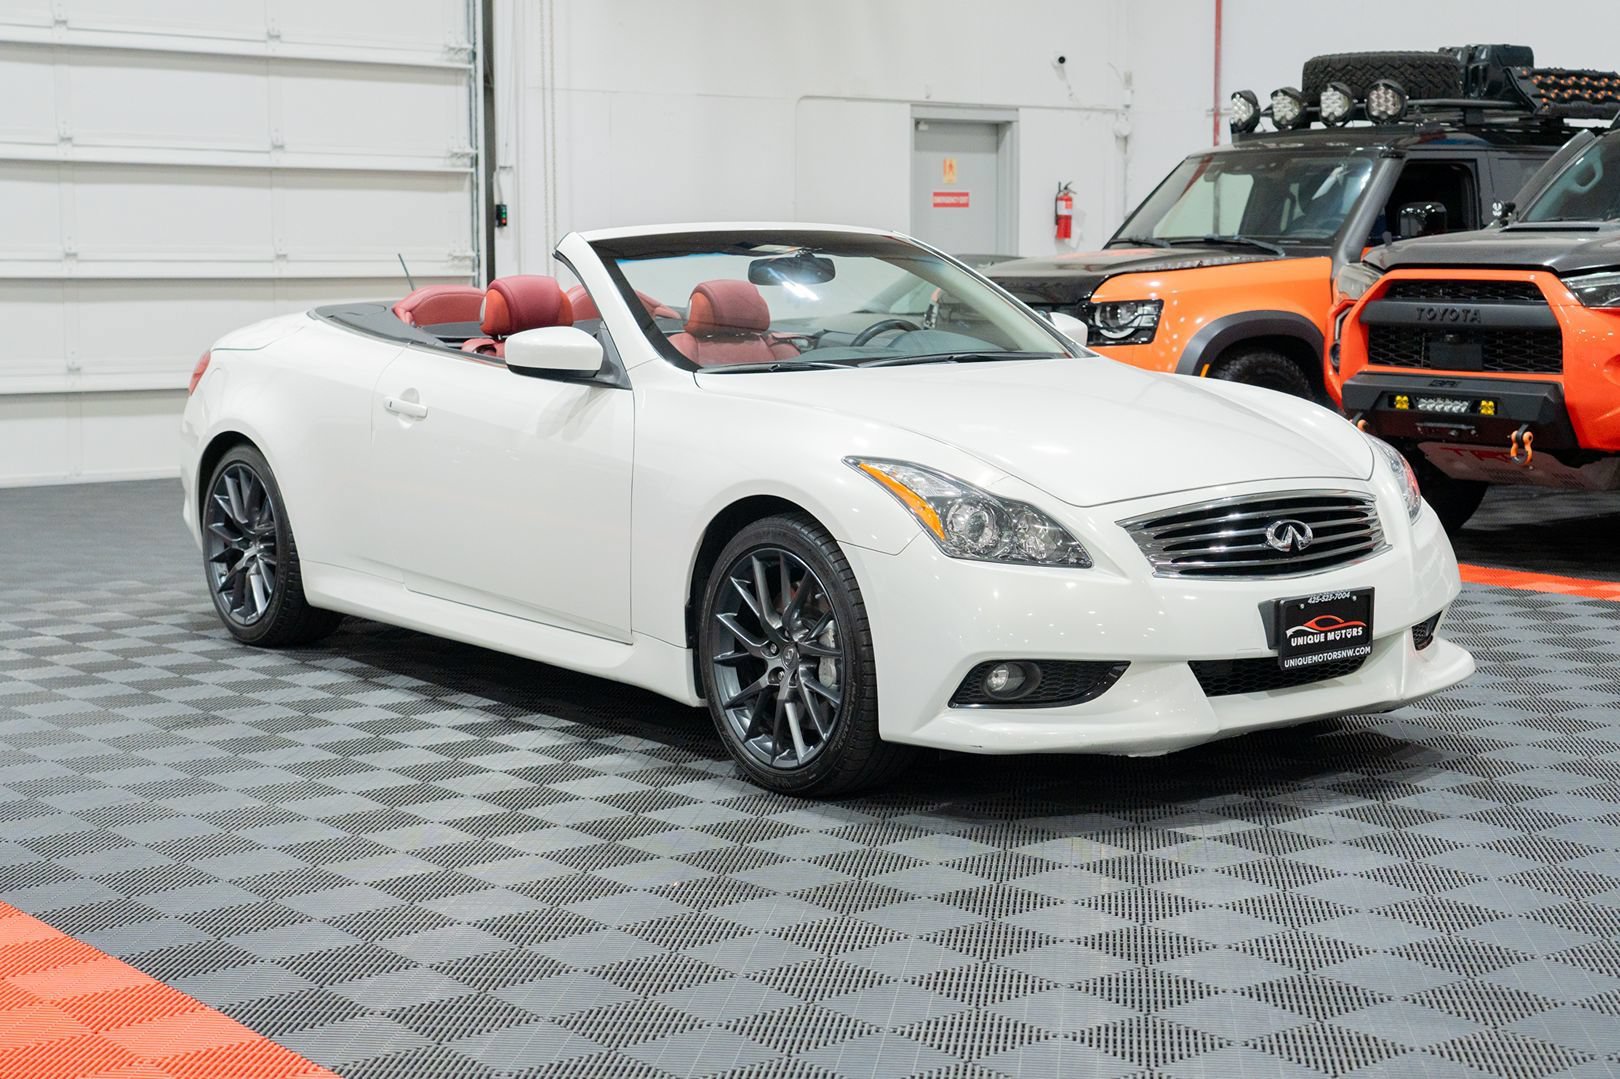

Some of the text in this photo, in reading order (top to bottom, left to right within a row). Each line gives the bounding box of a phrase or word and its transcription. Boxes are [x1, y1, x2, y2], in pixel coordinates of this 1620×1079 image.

[1416, 307, 1482, 323] TOYOTA
[1291, 627, 1363, 647] UNIQUE MOTORS
[1284, 646, 1371, 668] UNIQUEMOTORSNW.COM
